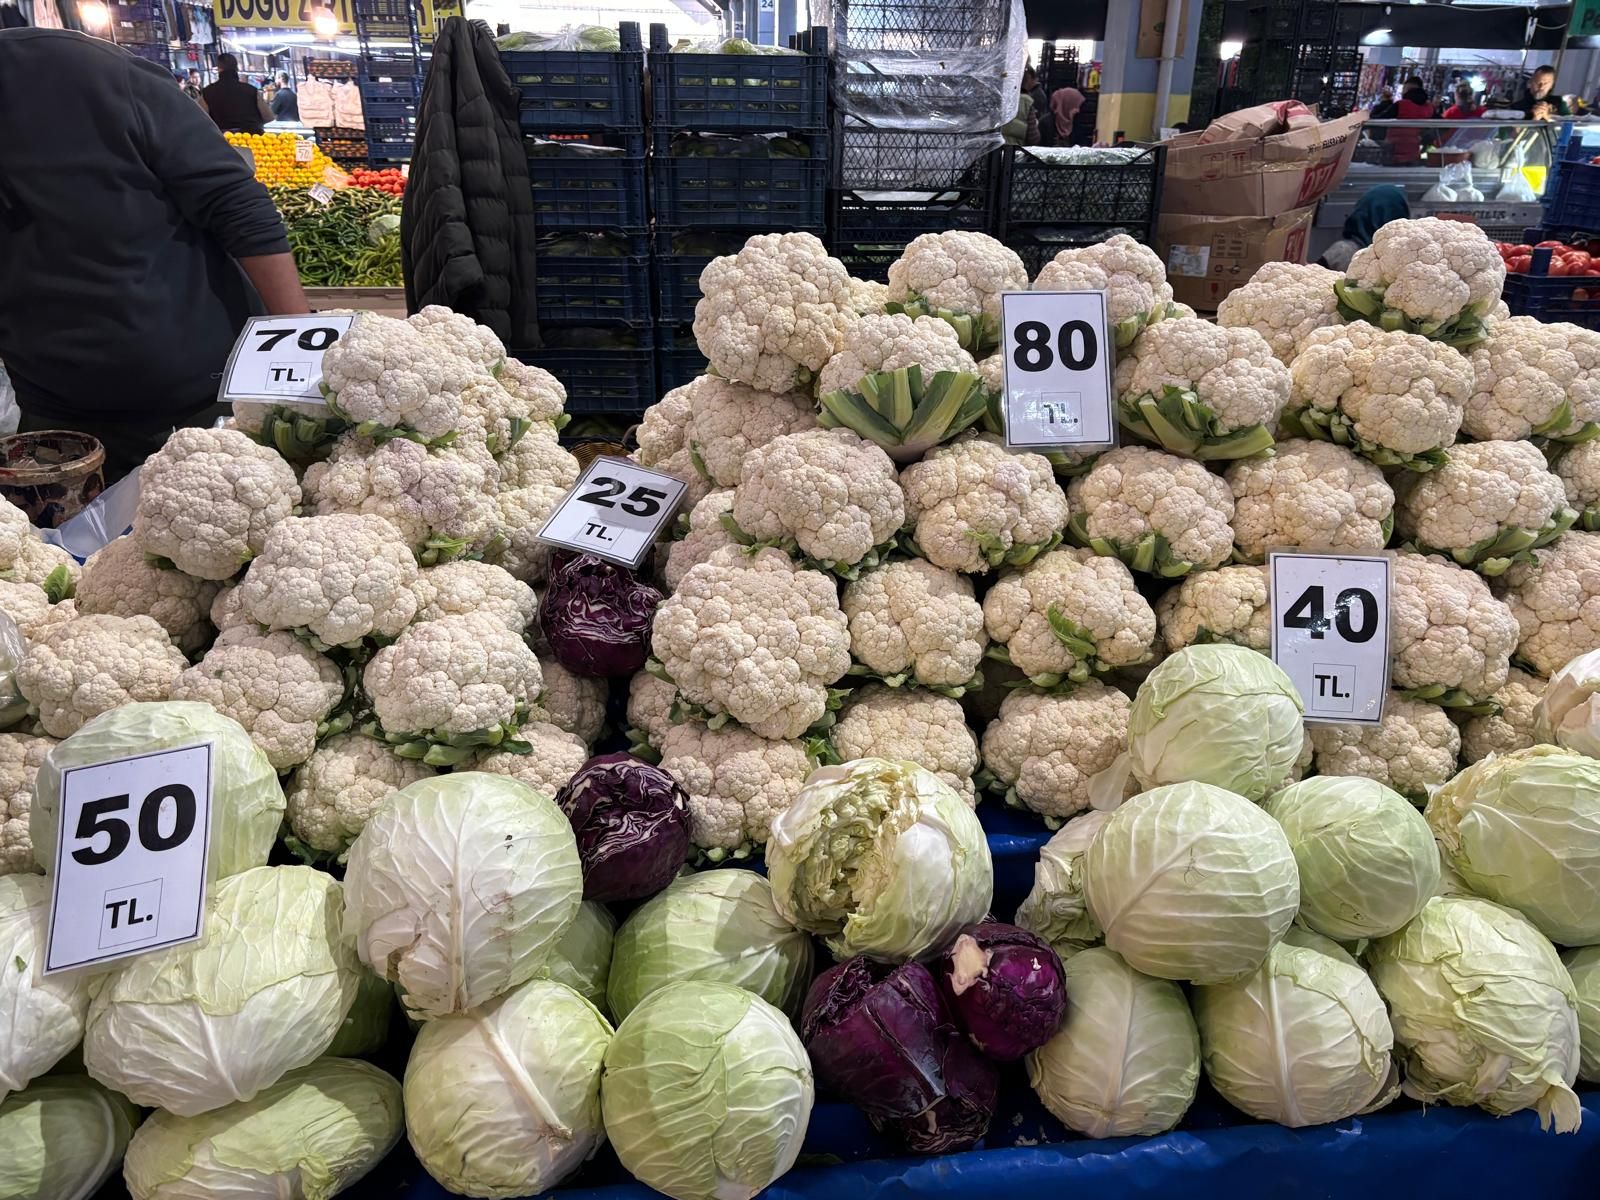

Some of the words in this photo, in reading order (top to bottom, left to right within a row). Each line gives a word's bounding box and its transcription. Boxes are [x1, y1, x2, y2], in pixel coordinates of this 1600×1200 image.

[255, 327, 339, 352] 70
[1013, 319, 1098, 372] 80
[270, 368, 305, 382] TL.
[576, 476, 668, 517] 25
[585, 522, 613, 542] TL.
[1283, 585, 1379, 643] 40
[1314, 674, 1350, 698] TL.
[71, 783, 197, 866] 50
[105, 897, 153, 929] TL.
